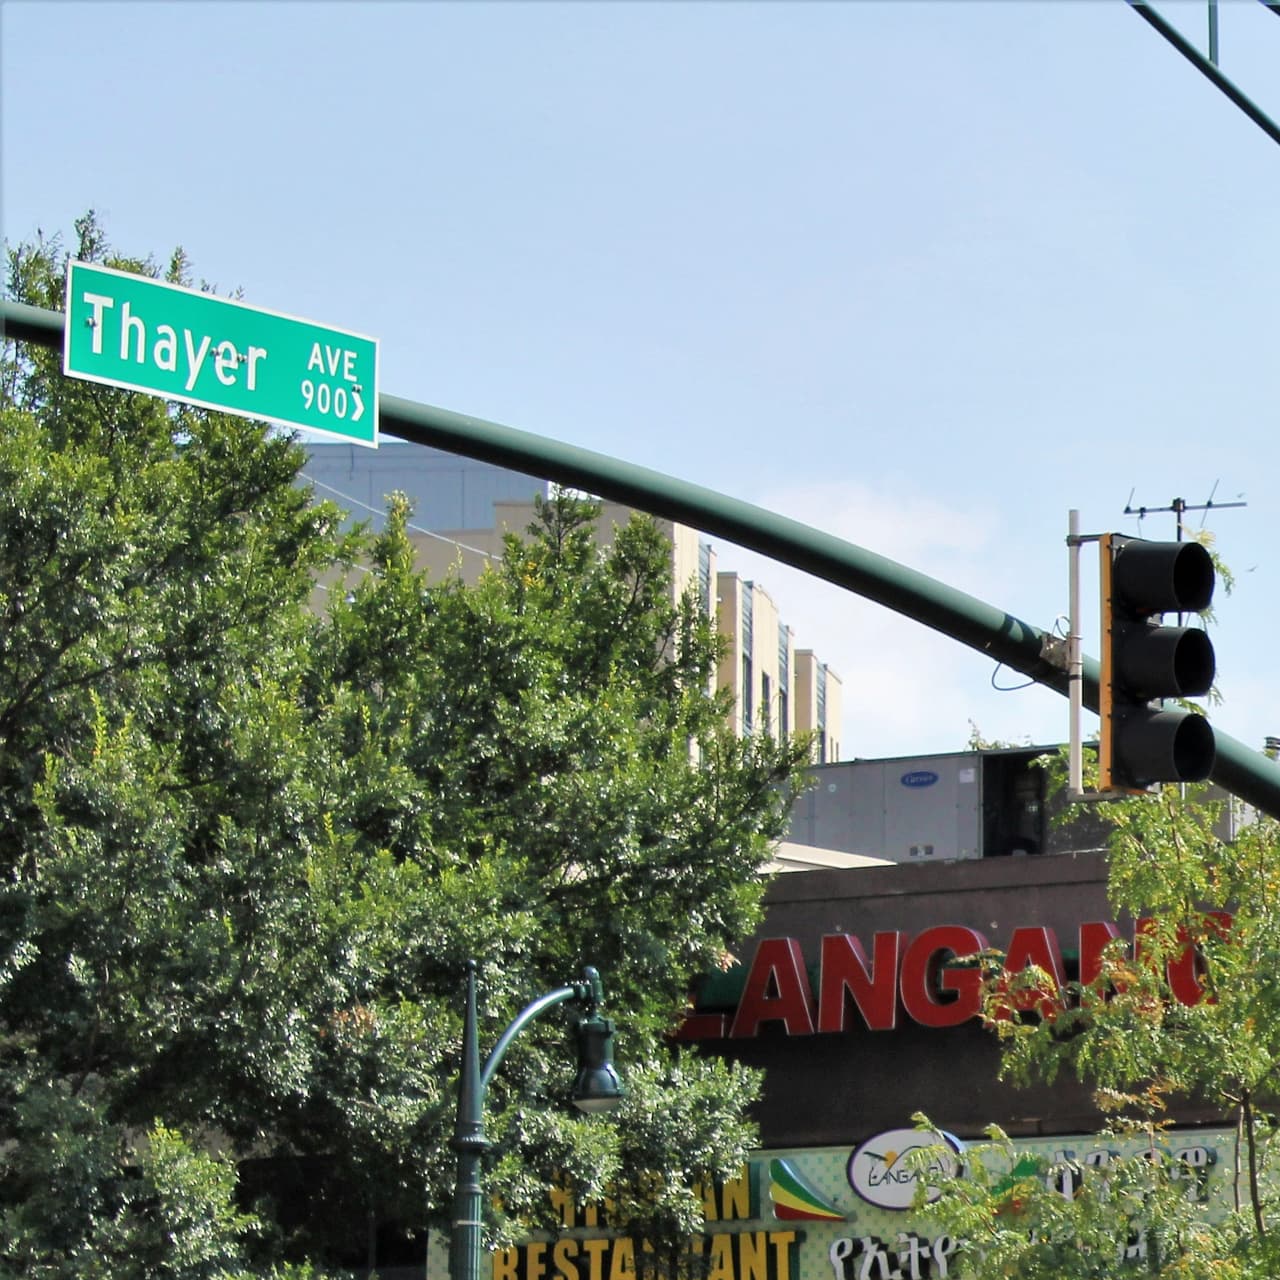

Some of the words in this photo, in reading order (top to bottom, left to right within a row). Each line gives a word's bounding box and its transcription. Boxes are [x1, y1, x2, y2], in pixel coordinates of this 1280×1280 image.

[84, 292, 267, 391] Thayer
[308, 342, 357, 382] AVE
[301, 380, 347, 418] 900
